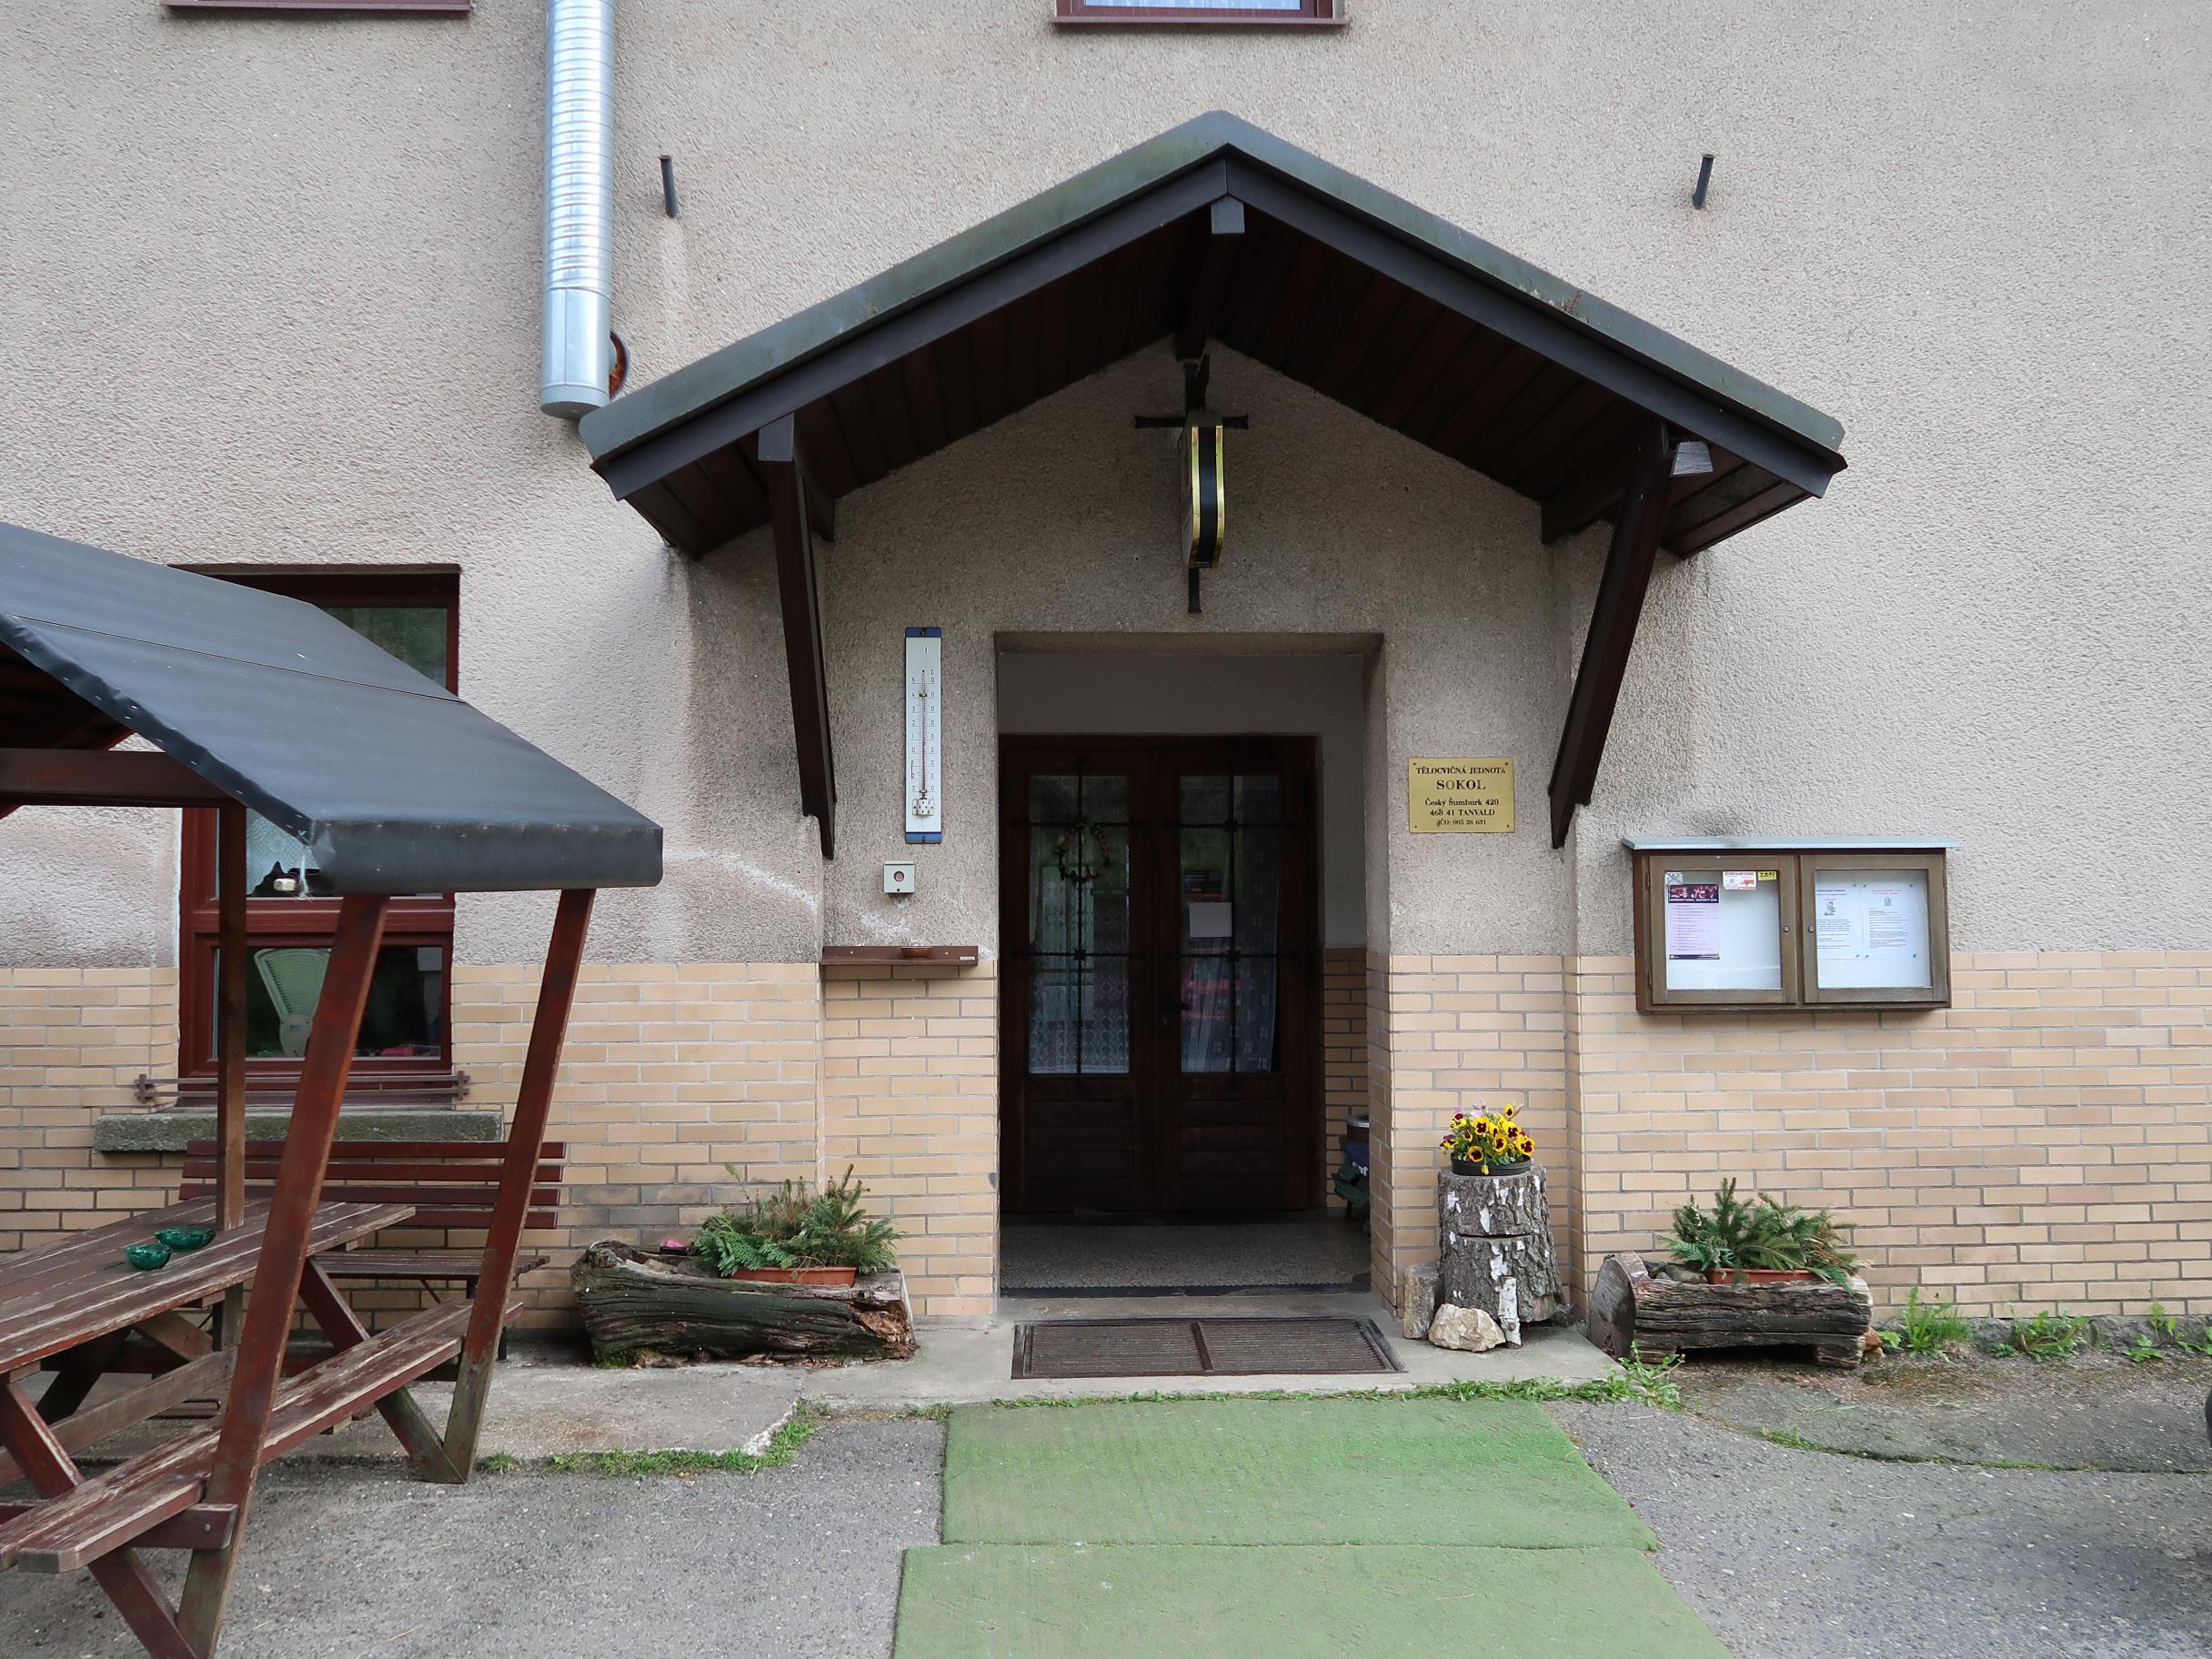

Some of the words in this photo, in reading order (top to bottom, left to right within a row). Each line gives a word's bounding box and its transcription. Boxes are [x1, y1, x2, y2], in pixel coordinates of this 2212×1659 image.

[1416, 765, 1466, 774] TĚLOCVIČNÁ
[1436, 779, 1486, 789] SOKOL
[1425, 797, 1446, 807] Český
[1448, 797, 1483, 806] Šumburk
